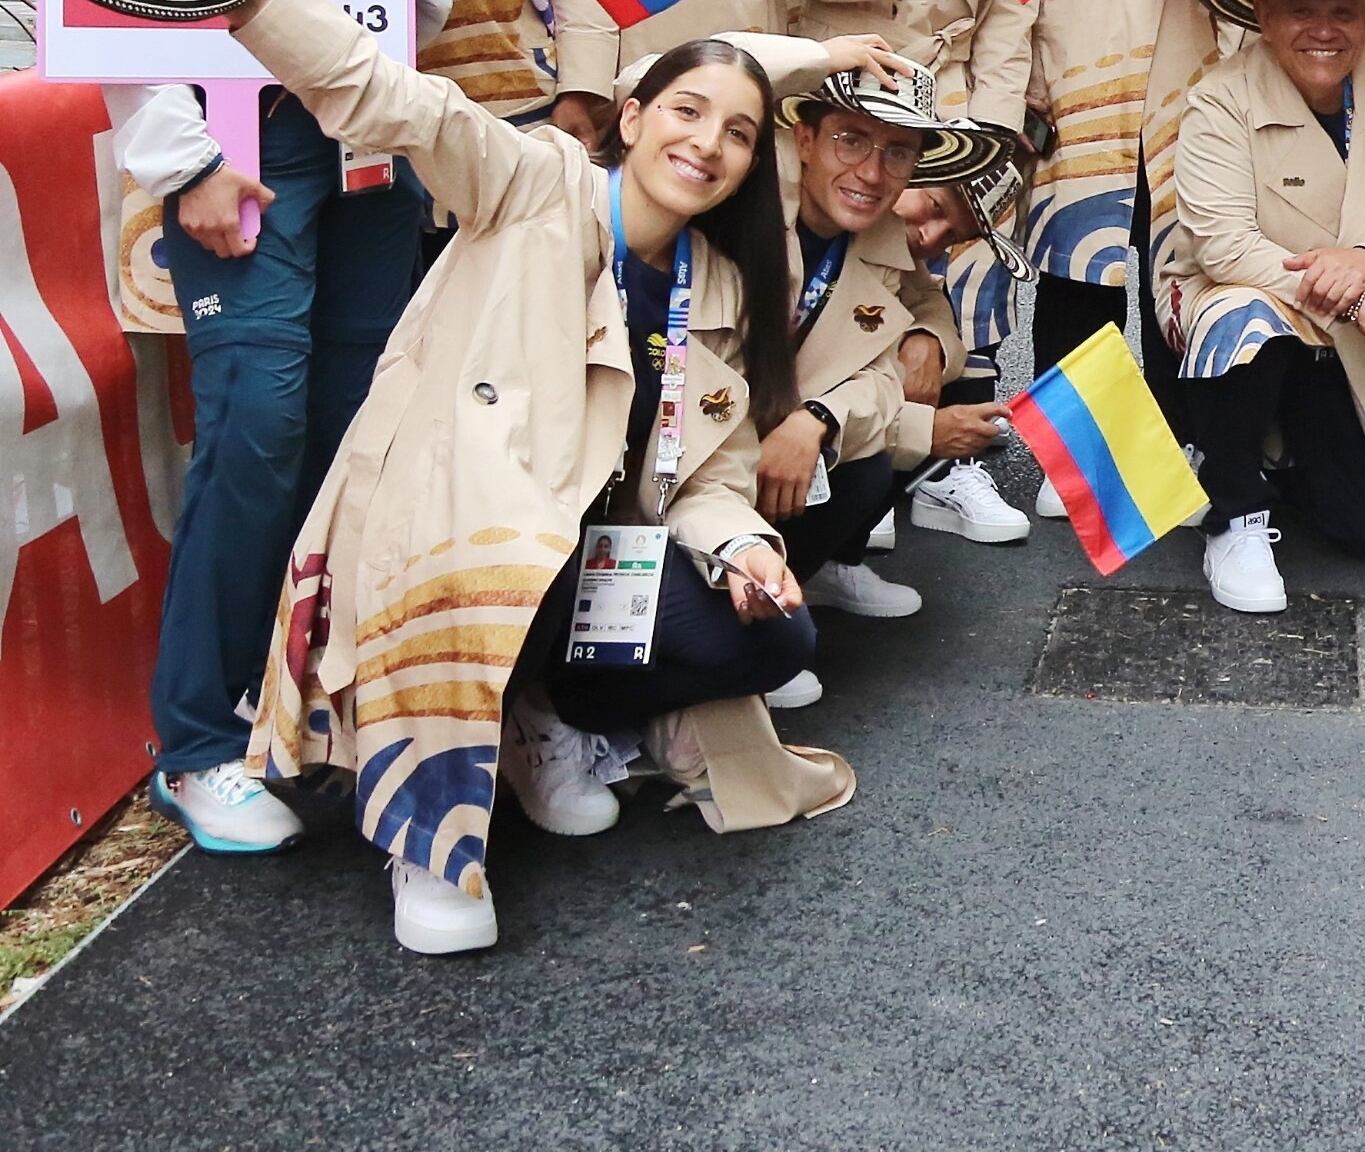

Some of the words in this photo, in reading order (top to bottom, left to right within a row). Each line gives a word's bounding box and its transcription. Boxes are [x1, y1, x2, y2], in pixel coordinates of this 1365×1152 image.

[383, 168, 389, 179] R
[192, 293, 220, 311] PARIS
[195, 304, 222, 320] 2024
[634, 646, 643, 659] R
